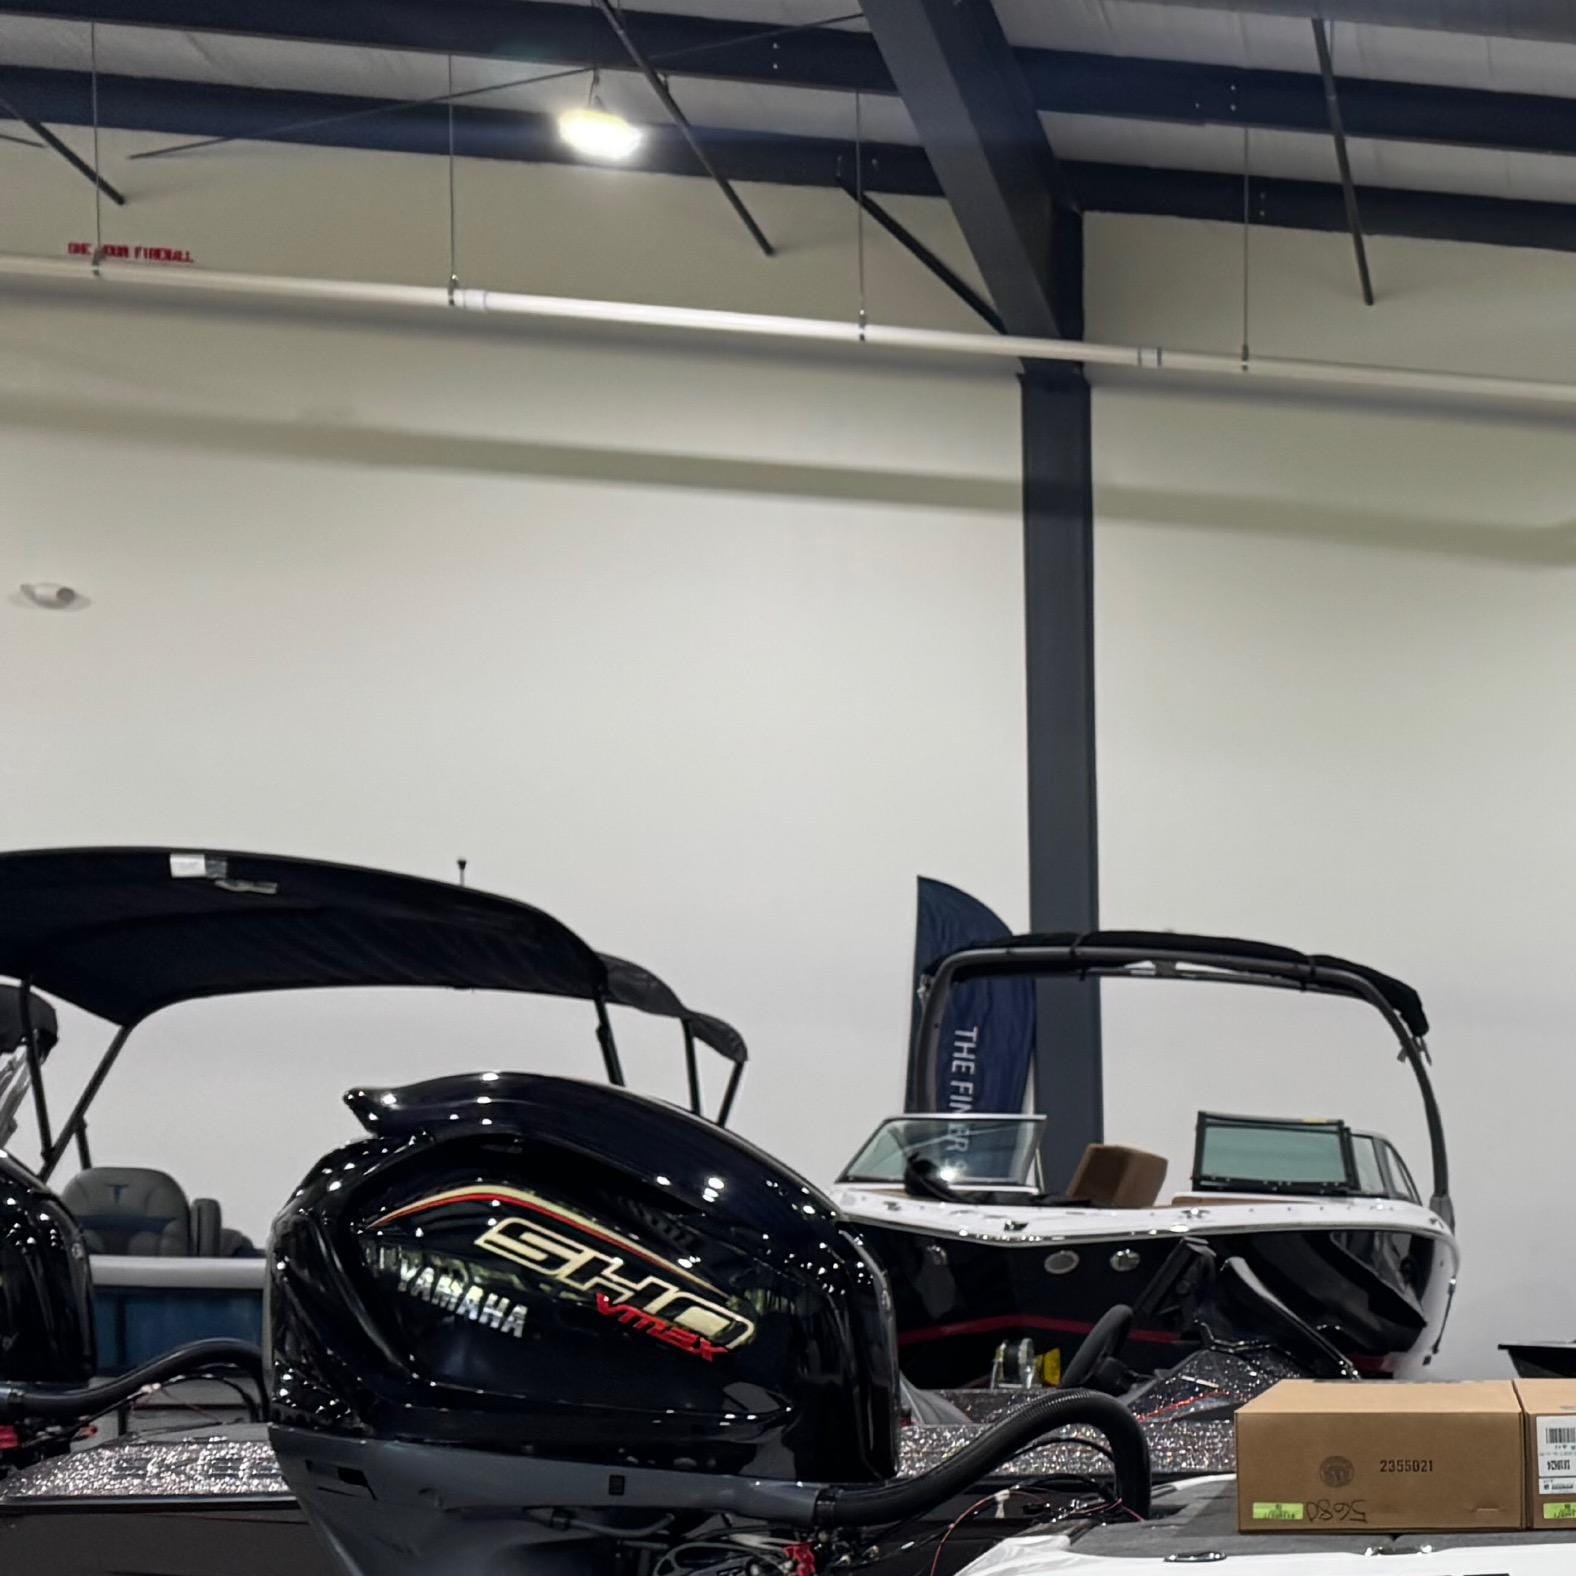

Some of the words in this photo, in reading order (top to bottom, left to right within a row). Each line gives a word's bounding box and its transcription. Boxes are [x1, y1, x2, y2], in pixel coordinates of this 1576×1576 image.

[951, 1026, 978, 1075] THE
[398, 1265, 529, 1338] YAMAHA
[473, 1216, 756, 1351] SHO
[1379, 1459, 1433, 1473] 2355021
